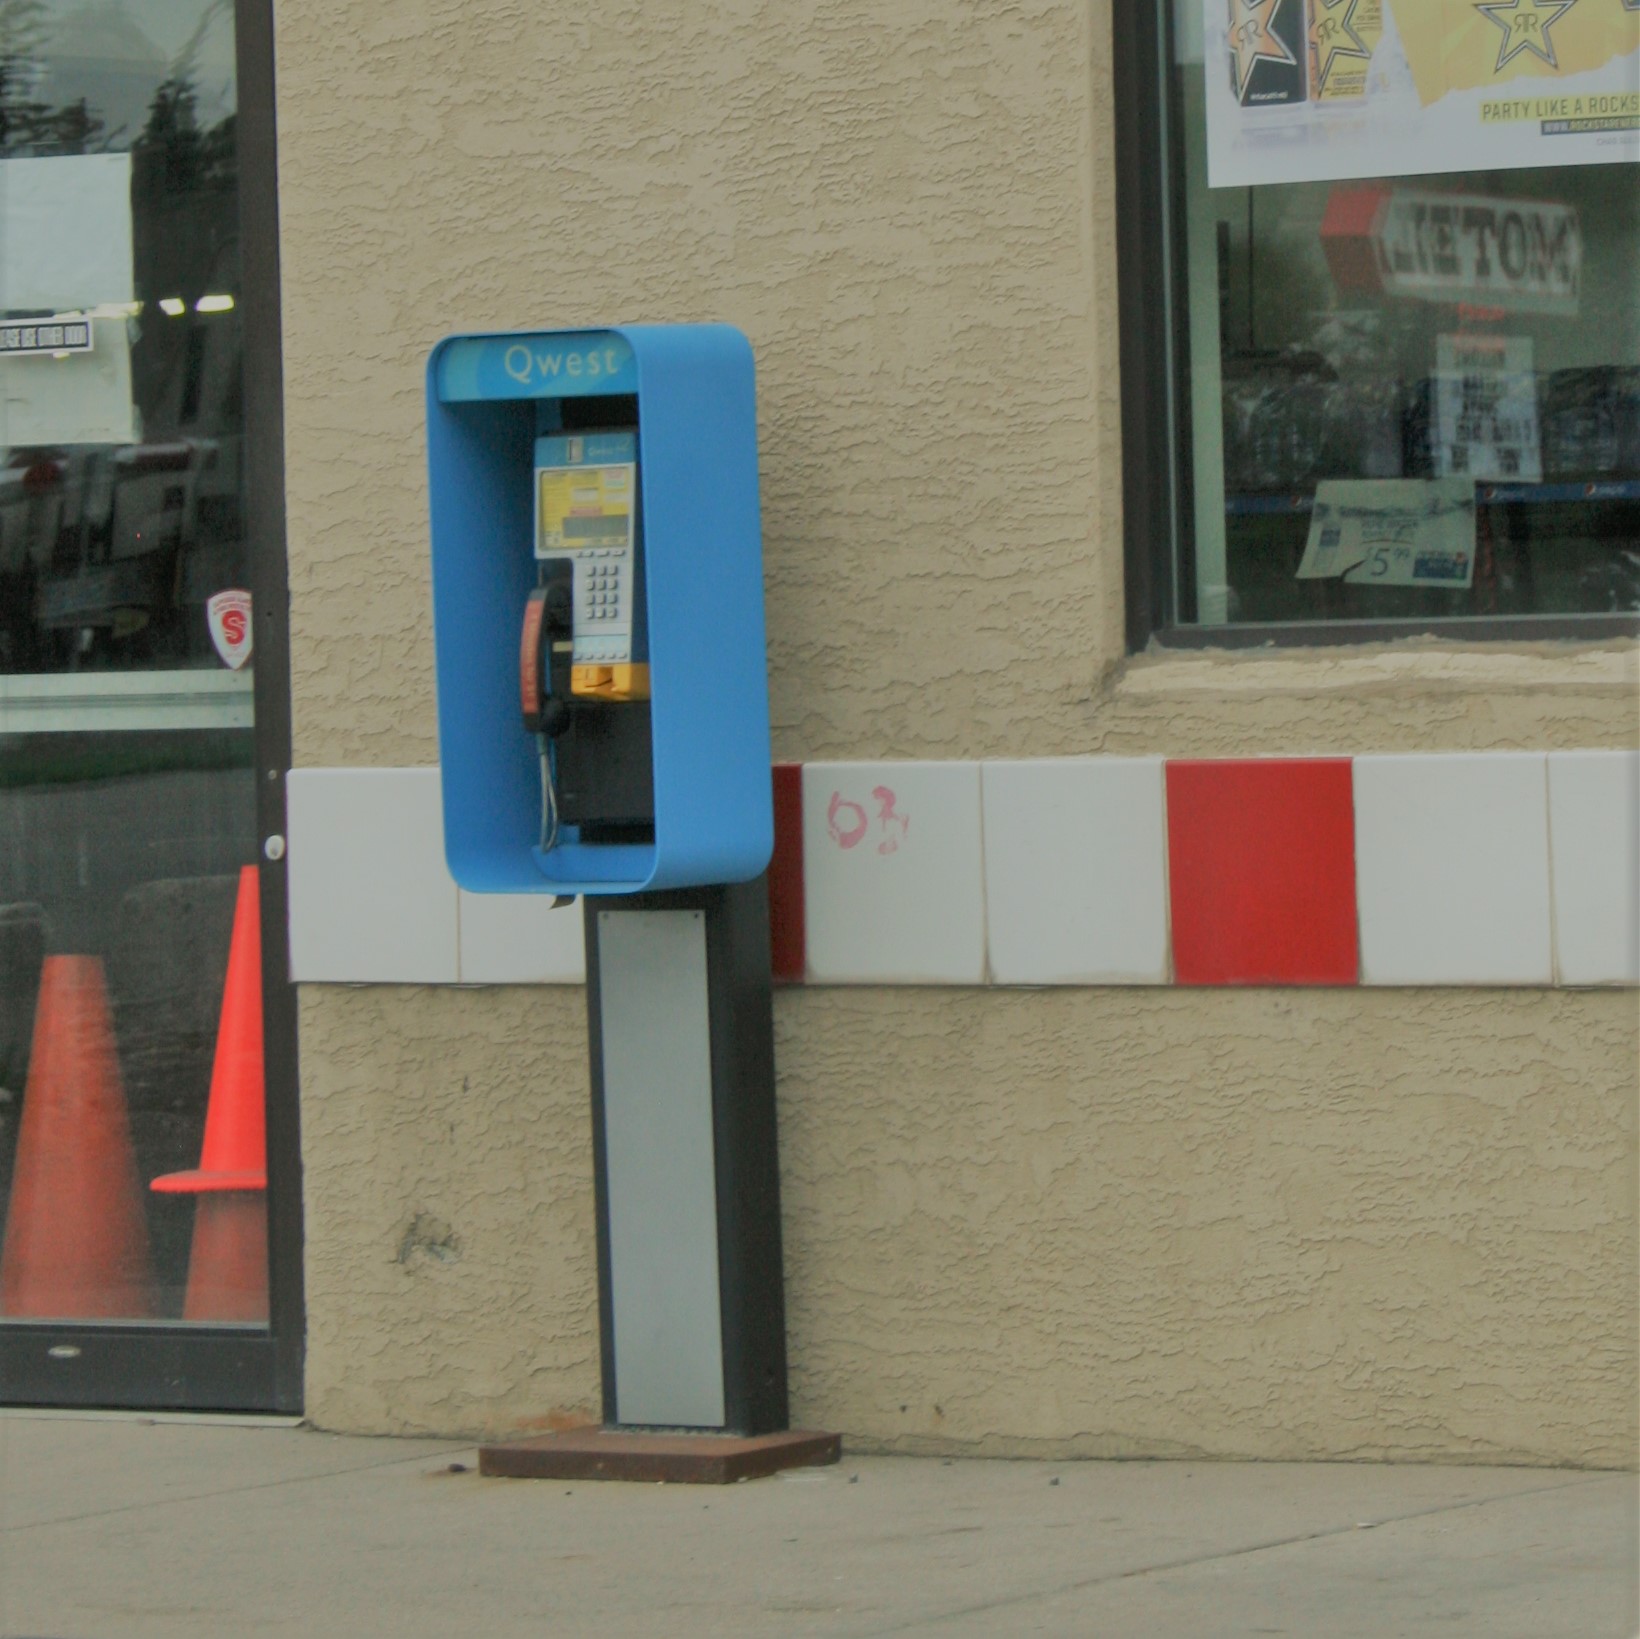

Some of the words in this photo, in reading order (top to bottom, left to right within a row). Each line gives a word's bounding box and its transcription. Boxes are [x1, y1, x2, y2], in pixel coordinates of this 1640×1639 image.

[1482, 101, 1530, 121] PARTY
[1535, 98, 1569, 117] LIKE
[1574, 97, 1582, 114] A
[504, 344, 618, 384] Qwest
